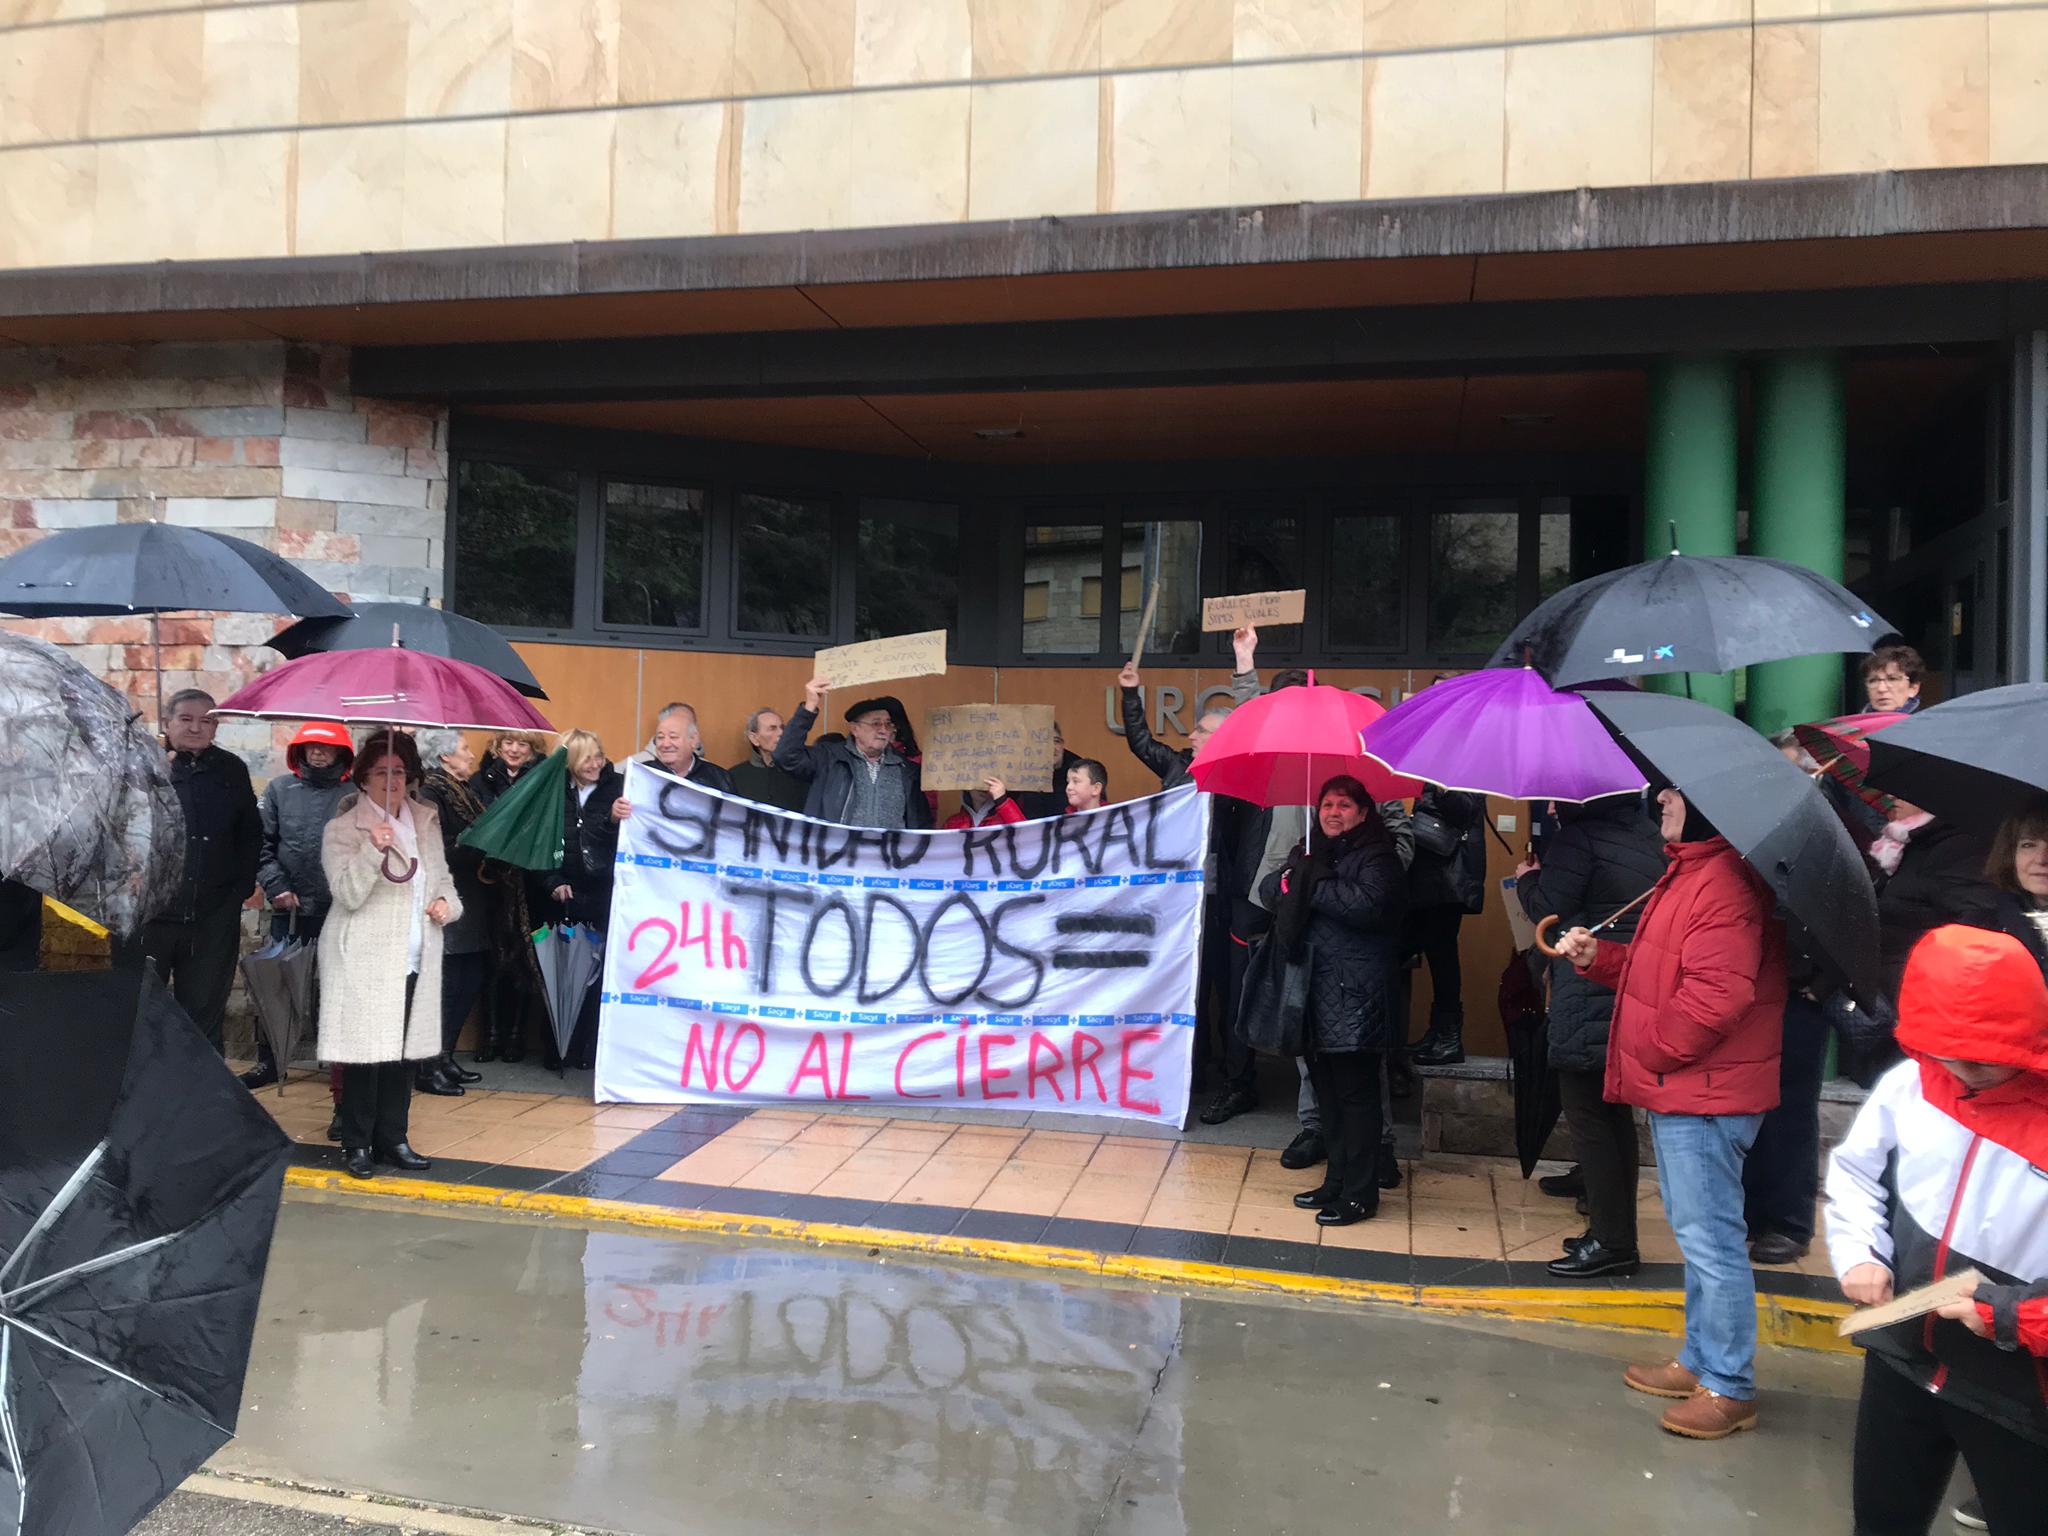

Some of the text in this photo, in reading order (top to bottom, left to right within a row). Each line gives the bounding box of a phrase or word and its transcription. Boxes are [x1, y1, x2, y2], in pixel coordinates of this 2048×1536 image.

[873, 651, 927, 664] CENTRO
[931, 711, 953, 727] EN
[962, 792, 1188, 879] RURAL
[627, 900, 747, 990] 24h
[725, 886, 1046, 1008] TODOS
[680, 1017, 1163, 1115] NO AL CIERRE
